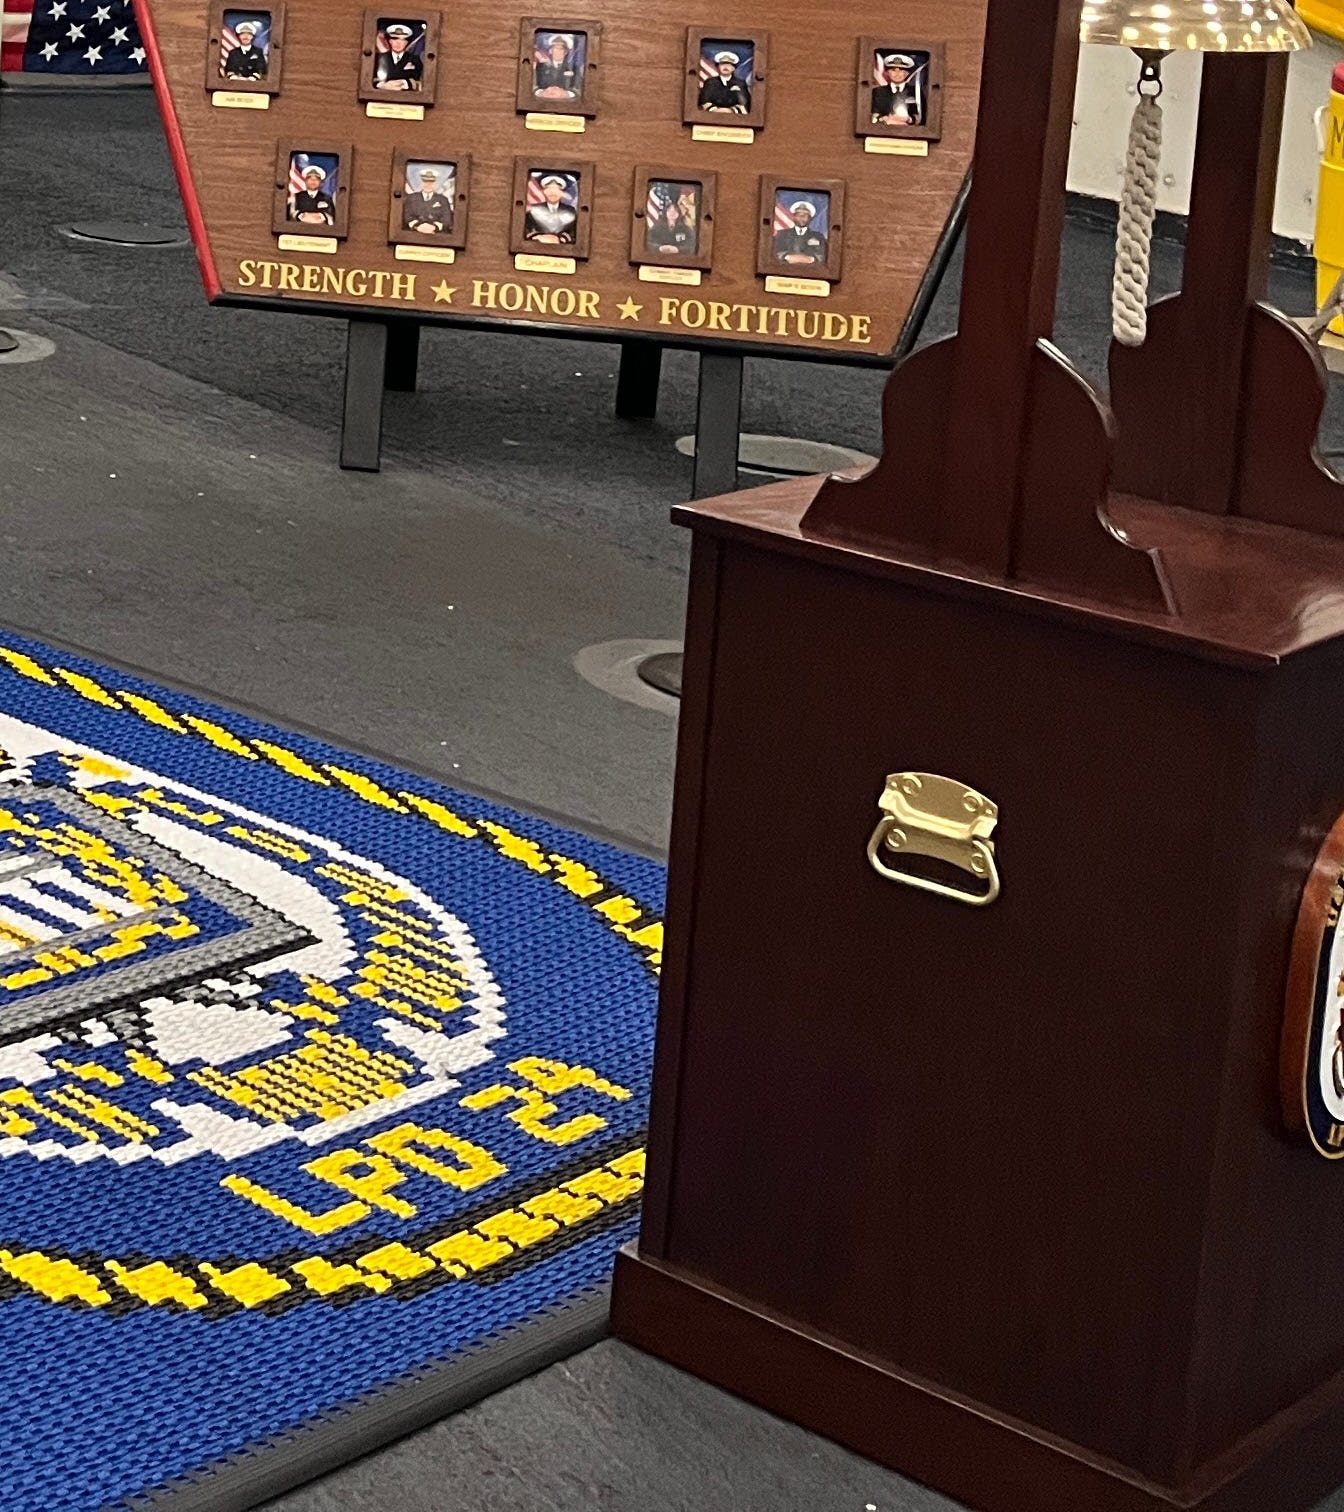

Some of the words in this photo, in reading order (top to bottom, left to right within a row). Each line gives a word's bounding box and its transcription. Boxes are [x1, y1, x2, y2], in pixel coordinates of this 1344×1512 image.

[238, 259, 417, 301] STRENGTH
[472, 281, 600, 319] HONOR
[659, 297, 872, 344] FORTITUDE
[219, 1122, 510, 1236] LPD
